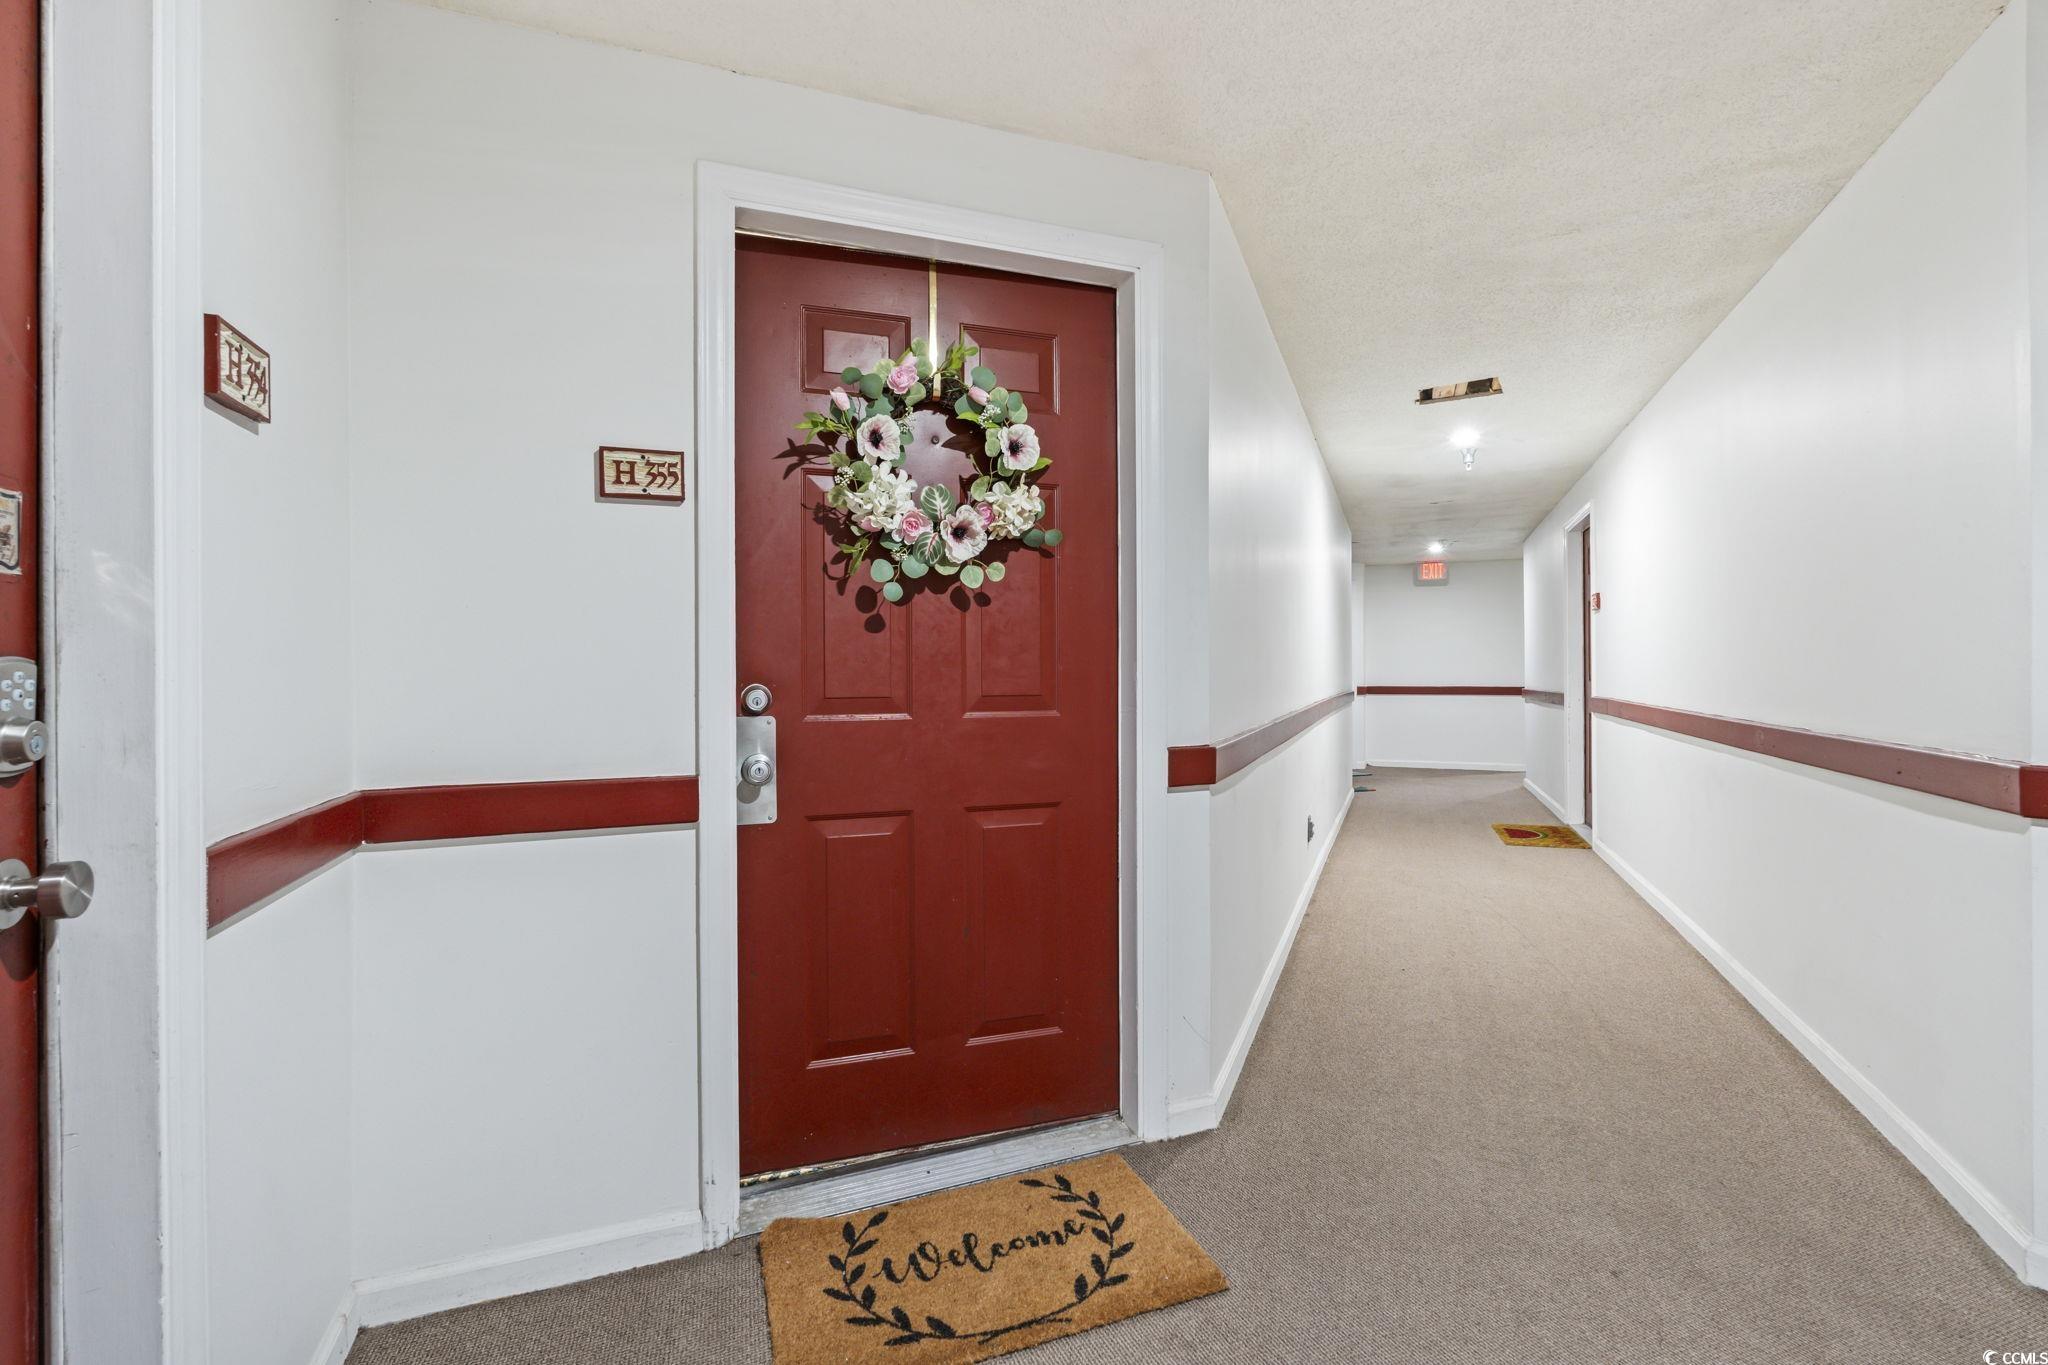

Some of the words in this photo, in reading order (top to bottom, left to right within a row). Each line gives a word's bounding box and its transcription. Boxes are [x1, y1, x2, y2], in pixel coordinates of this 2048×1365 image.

[225, 340, 244, 390] H
[612, 460, 640, 486] H
[644, 459, 680, 490] 355
[1422, 562, 1445, 579] EXIT
[872, 1218, 1086, 1284] Welcome
